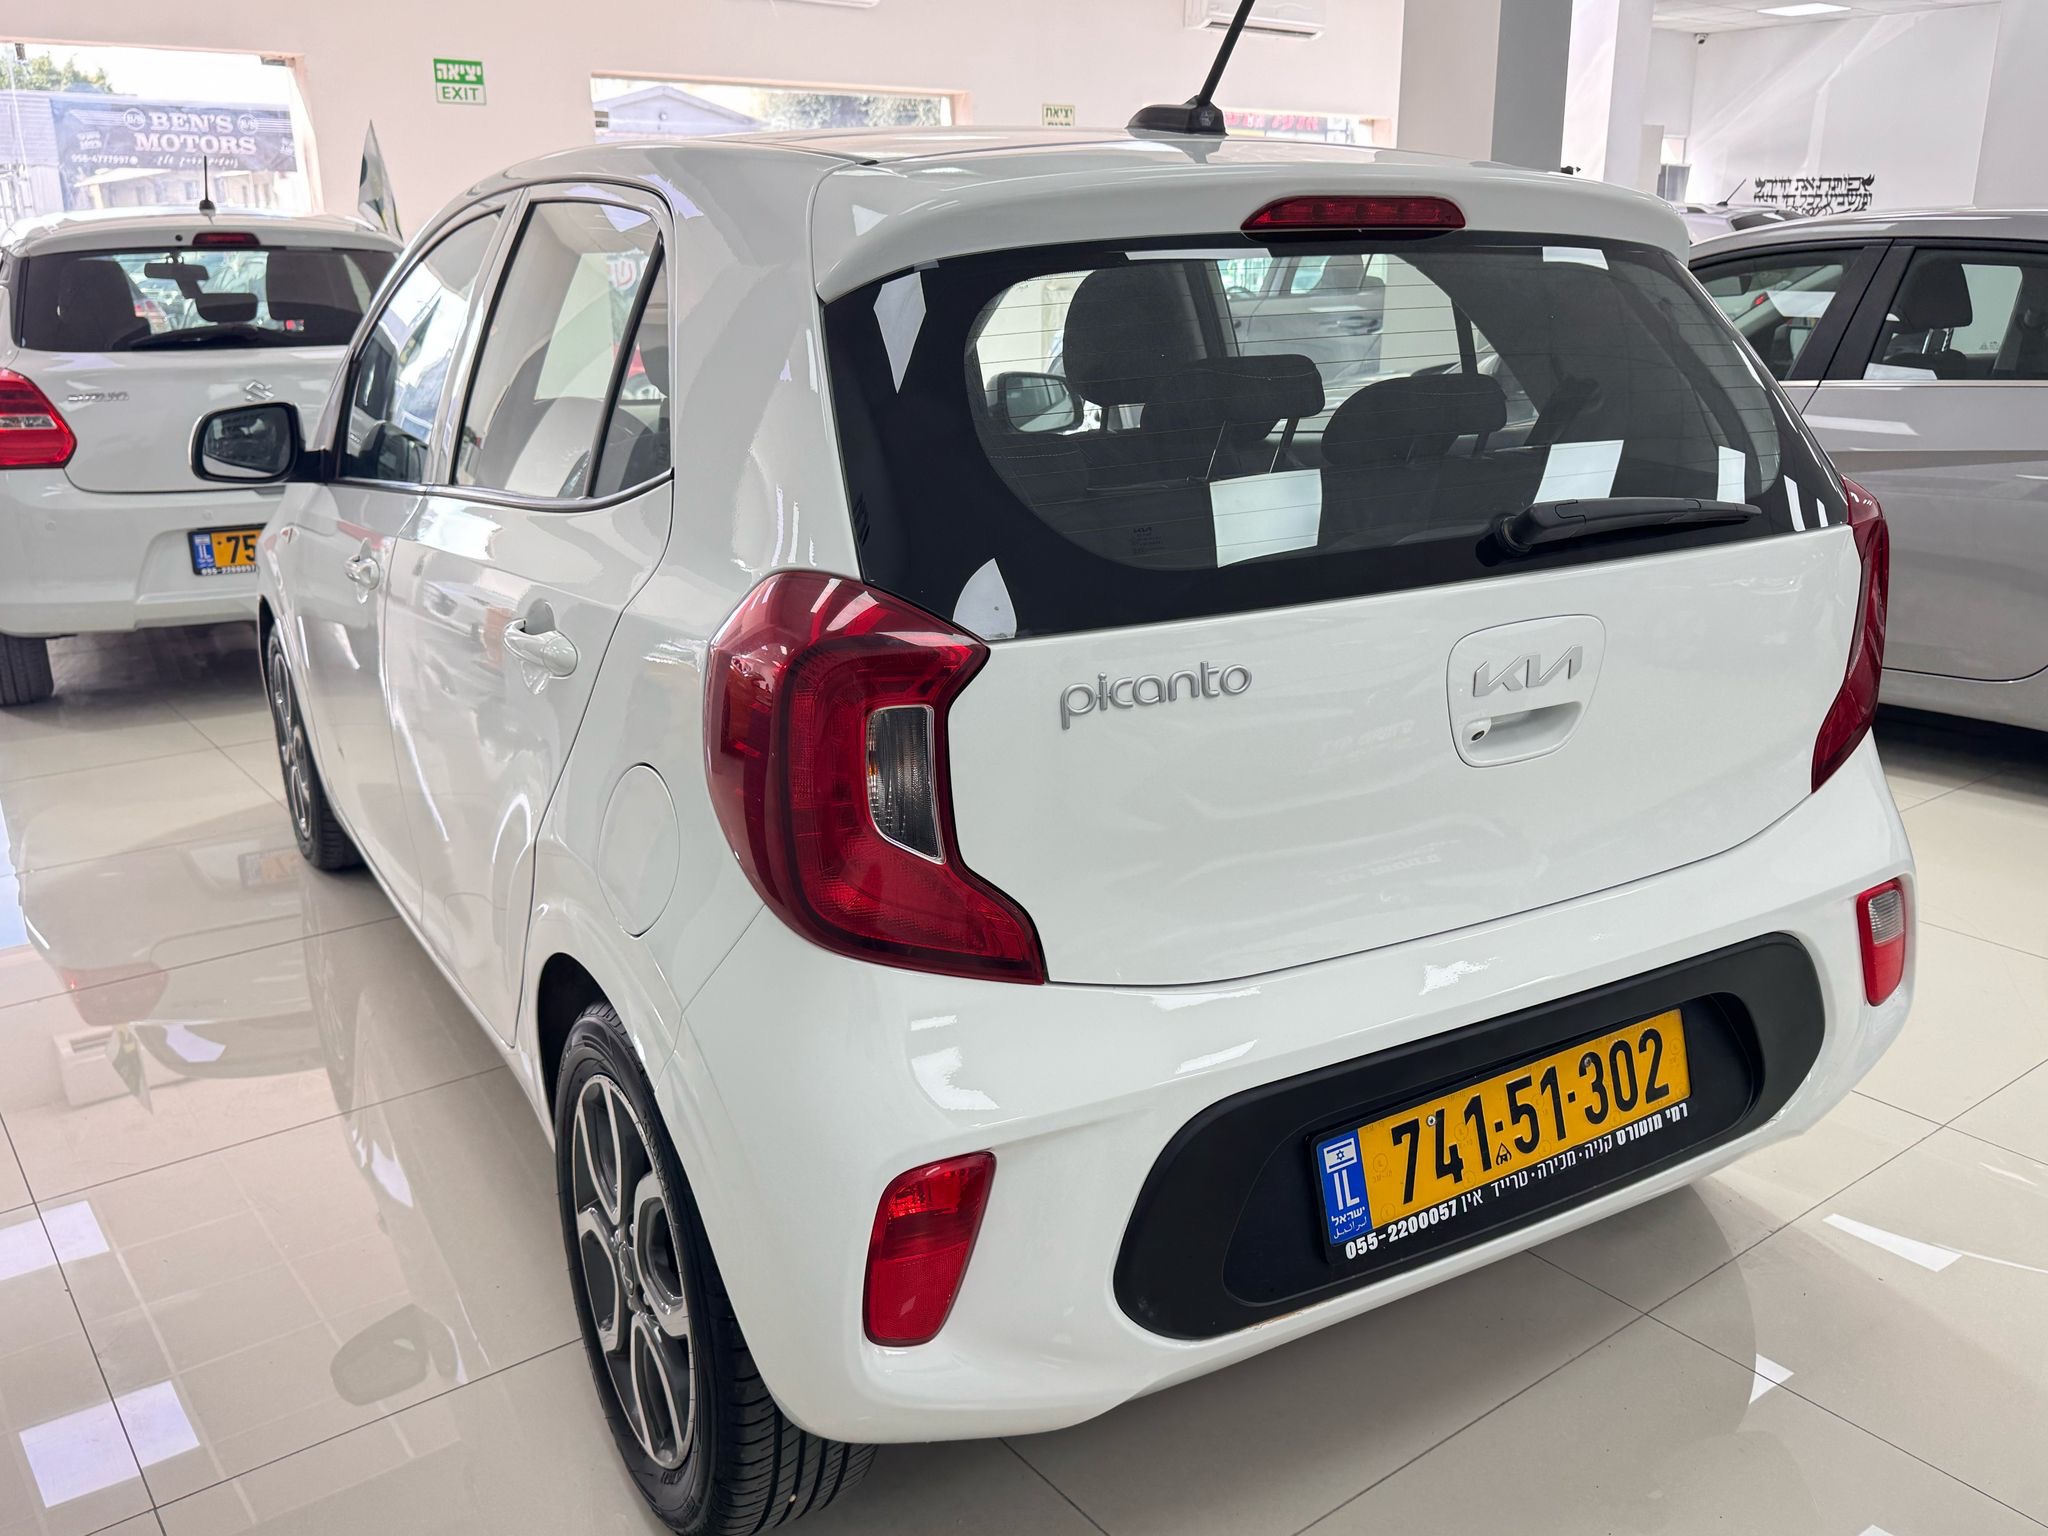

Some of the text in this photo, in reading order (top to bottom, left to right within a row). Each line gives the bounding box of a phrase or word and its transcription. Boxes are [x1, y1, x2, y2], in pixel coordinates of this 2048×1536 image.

[436, 63, 481, 81] יציאה
[442, 86, 480, 100] EXIT
[149, 112, 234, 132] BEN'S
[134, 132, 257, 155] MOTORS
[198, 545, 212, 560] IL
[226, 534, 256, 563] 75
[1473, 645, 1583, 697] KIA
[1060, 661, 1252, 730] picanto
[1666, 1102, 1688, 1123] רמי
[1615, 1113, 1663, 1146] מוטורס
[1333, 1168, 1360, 1210] IL
[1461, 1188, 1484, 1212] אין
[1331, 1206, 1366, 1226] ישראל
[1344, 1199, 1457, 1260] 055-2200057
